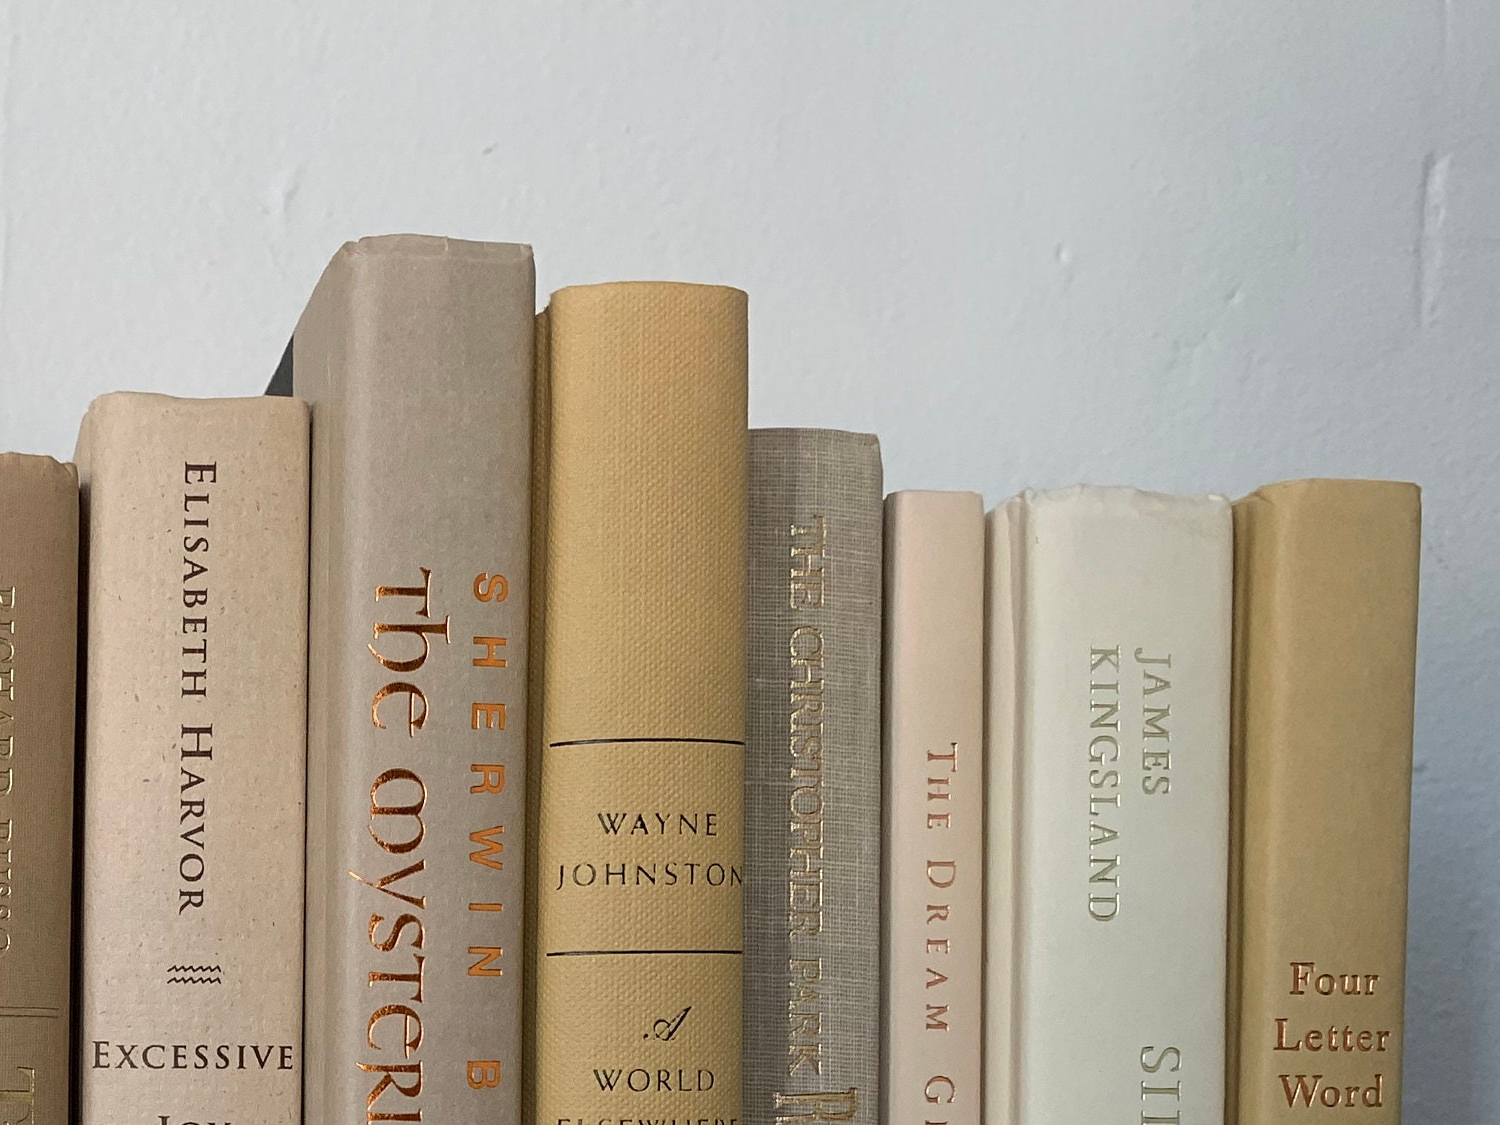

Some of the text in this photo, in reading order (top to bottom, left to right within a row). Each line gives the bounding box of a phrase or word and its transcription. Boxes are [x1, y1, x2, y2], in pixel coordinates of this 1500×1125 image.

[789, 512, 829, 609] THE
[178, 461, 217, 914] ELISABETH HARVOR
[367, 567, 451, 738] The
[1134, 647, 1171, 796] JAMES
[468, 572, 509, 976] SHERWIN
[789, 623, 824, 942] CHRISTOPHER
[926, 741, 959, 831] THE
[1088, 644, 1122, 923] KINGSLAND
[598, 812, 718, 836] WAYNE
[556, 861, 742, 891] JOHNSTON
[925, 859, 957, 1033] DREAM
[1288, 962, 1380, 997] Four
[92, 1041, 294, 1072] EXCESSIVE
[642, 1006, 693, 1042] A
[788, 956, 823, 1077] PARK
[1273, 1018, 1391, 1054] Letter
[592, 1068, 716, 1092] WORLD
[1278, 1074, 1384, 1109] Word
